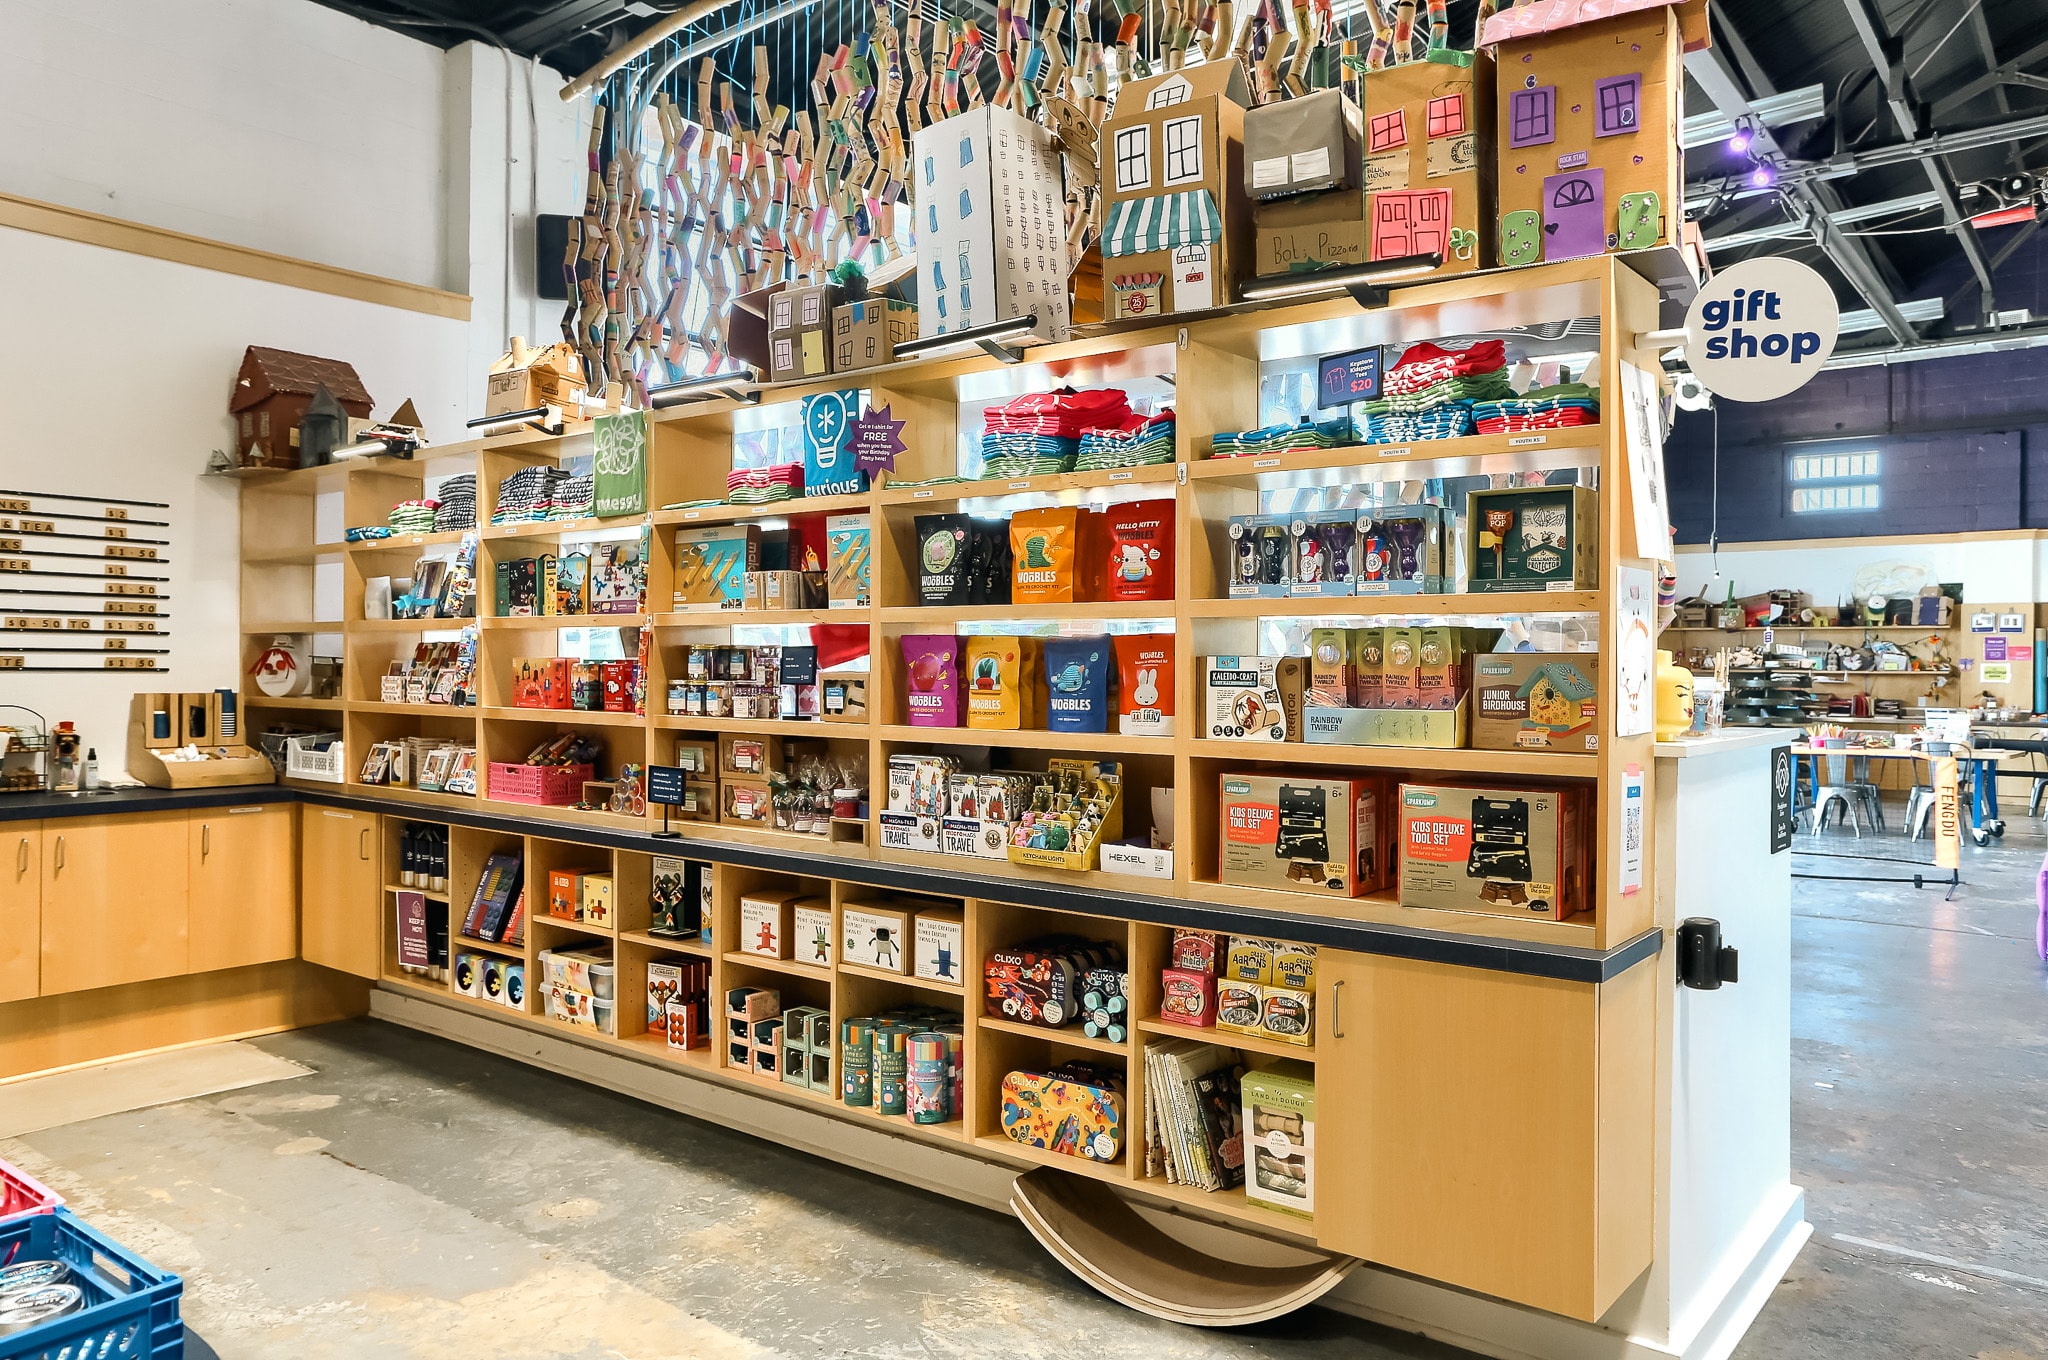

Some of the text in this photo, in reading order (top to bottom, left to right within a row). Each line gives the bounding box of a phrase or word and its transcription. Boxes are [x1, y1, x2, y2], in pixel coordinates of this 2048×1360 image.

[1702, 288, 1781, 331] gift
[1706, 328, 1821, 364] shop
[1350, 378, 1372, 393] $20
[863, 432, 887, 442] FREE
[804, 478, 859, 498] curious
[22, 521, 54, 532] TEA
[1116, 520, 1160, 531] HELLO KITTY
[1527, 561, 1560, 571] PROTECTOR
[69, 620, 90, 629] TO
[1212, 672, 1257, 681] KALEIDO-CRAFT
[1385, 673, 1410, 682] RAINBOW
[1482, 690, 1510, 700] JUNIOR
[1482, 700, 1526, 711] BIRDHOUSE
[1310, 716, 1342, 724] RAINBOW
[1310, 723, 1339, 732] TWIRLER
[891, 774, 911, 786] TRAVEL
[1332, 790, 1343, 798] 6+
[1406, 797, 1435, 806] SPARKJUMP
[1229, 806, 1274, 820] KIDS DELUXE
[1536, 803, 1549, 812] 6+
[949, 823, 979, 832] MAGNA-TILES
[1229, 816, 1261, 829] TOOL SET
[1411, 821, 1465, 836] KIDS DELUXE
[884, 830, 911, 846] TRAVEL
[1411, 832, 1449, 845] TOOL SET
[946, 836, 977, 853] TRAVEL
[1022, 853, 1066, 863] KEYCHAIN LIGHTS
[1108, 853, 1146, 865] HEXEL
[937, 924, 960, 933] CREATURES
[994, 953, 1022, 966] CLIXO
[1250, 951, 1266, 959] CRAZY
[1295, 958, 1313, 966] CRAZY
[1090, 972, 1115, 982] CLIXO
[1010, 1075, 1040, 1089] CLIXO
[1251, 1091, 1270, 1100] LAND
[1280, 1097, 1306, 1107] DOUGH
